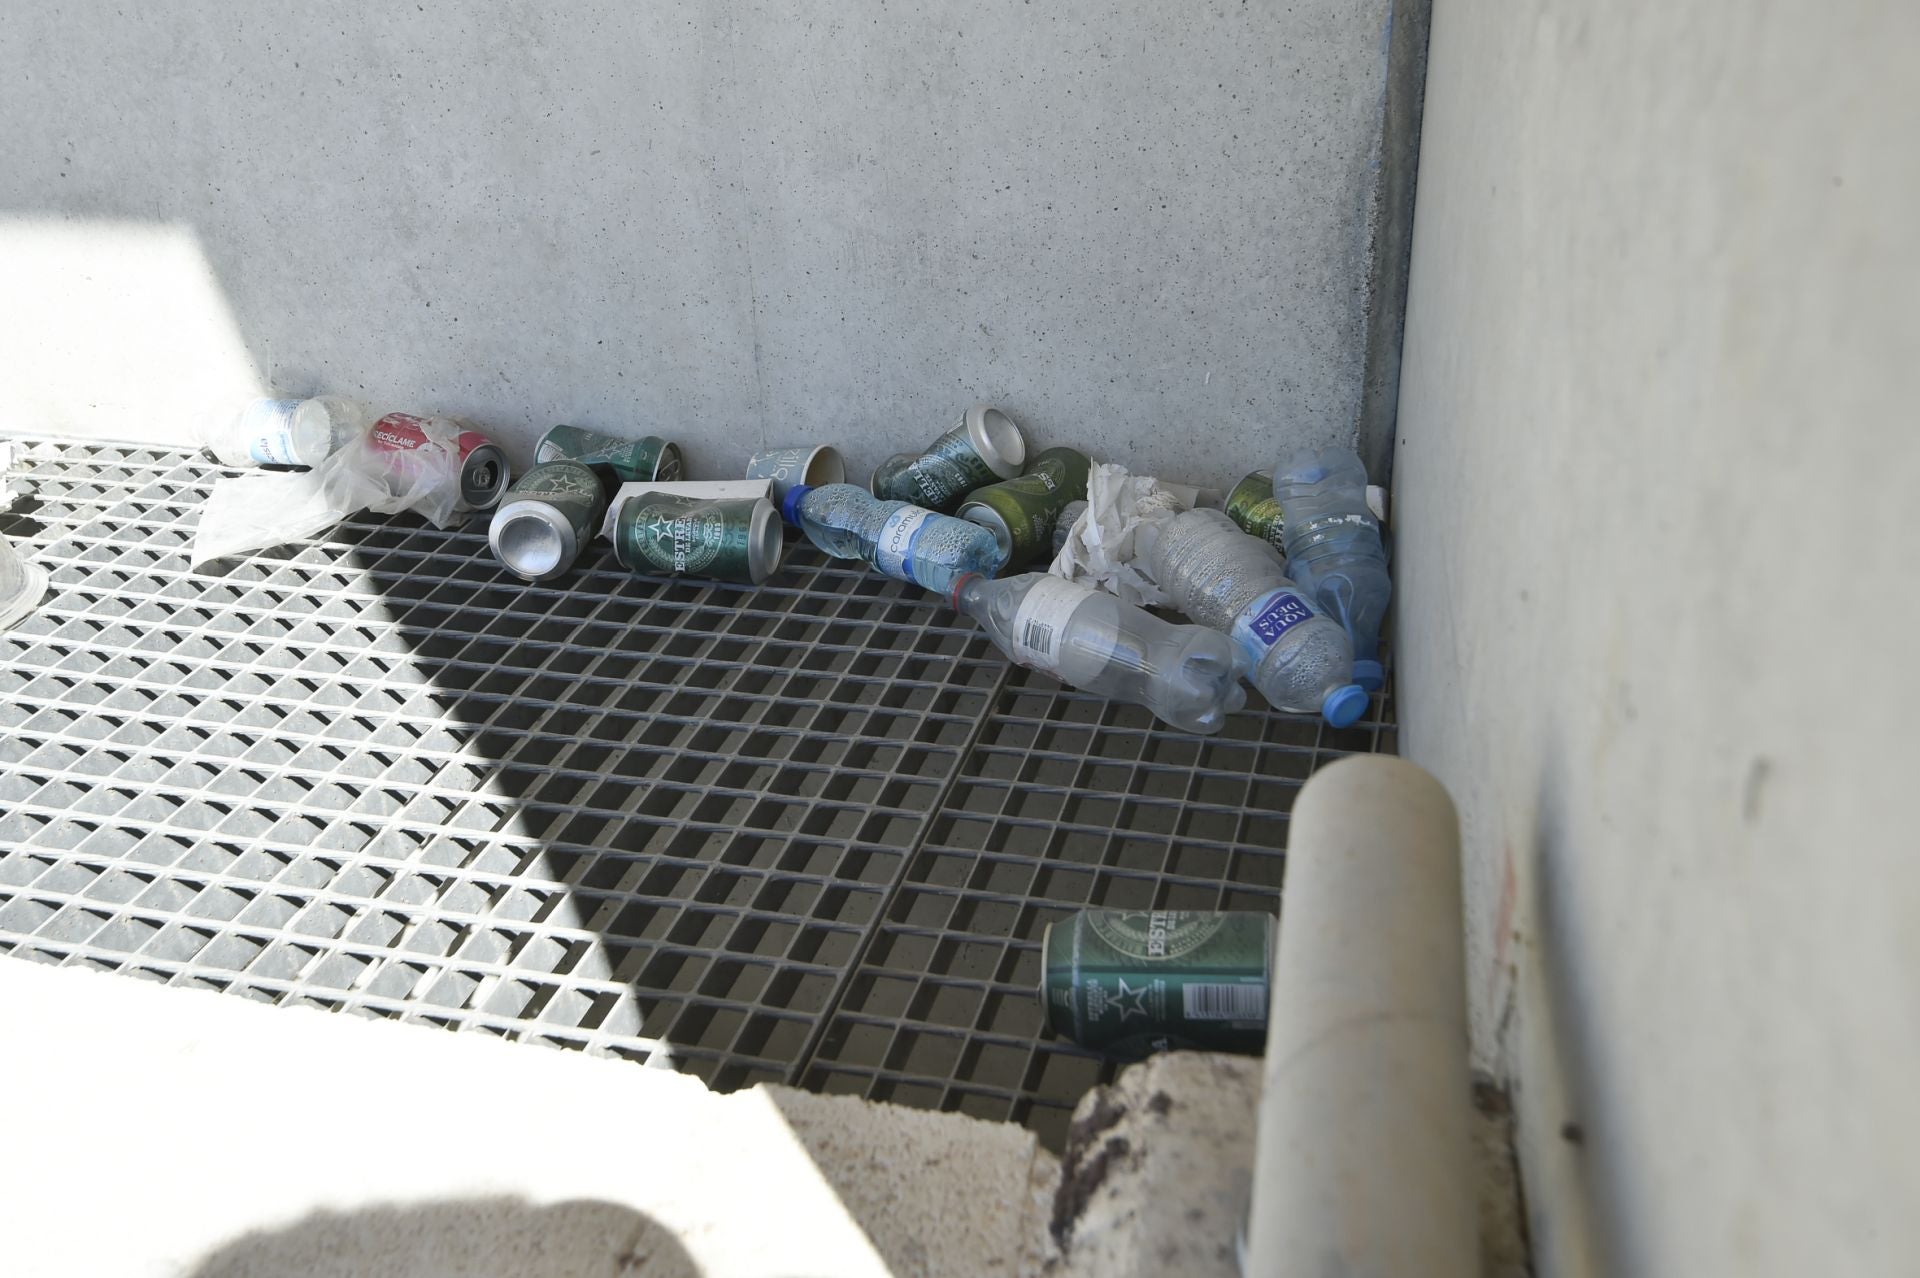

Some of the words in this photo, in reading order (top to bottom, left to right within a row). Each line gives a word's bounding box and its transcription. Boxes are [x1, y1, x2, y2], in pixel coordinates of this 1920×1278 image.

[674, 516, 686, 573] ESTRE
[1258, 602, 1300, 630] DEUS
[1264, 609, 1308, 637] AQUA
